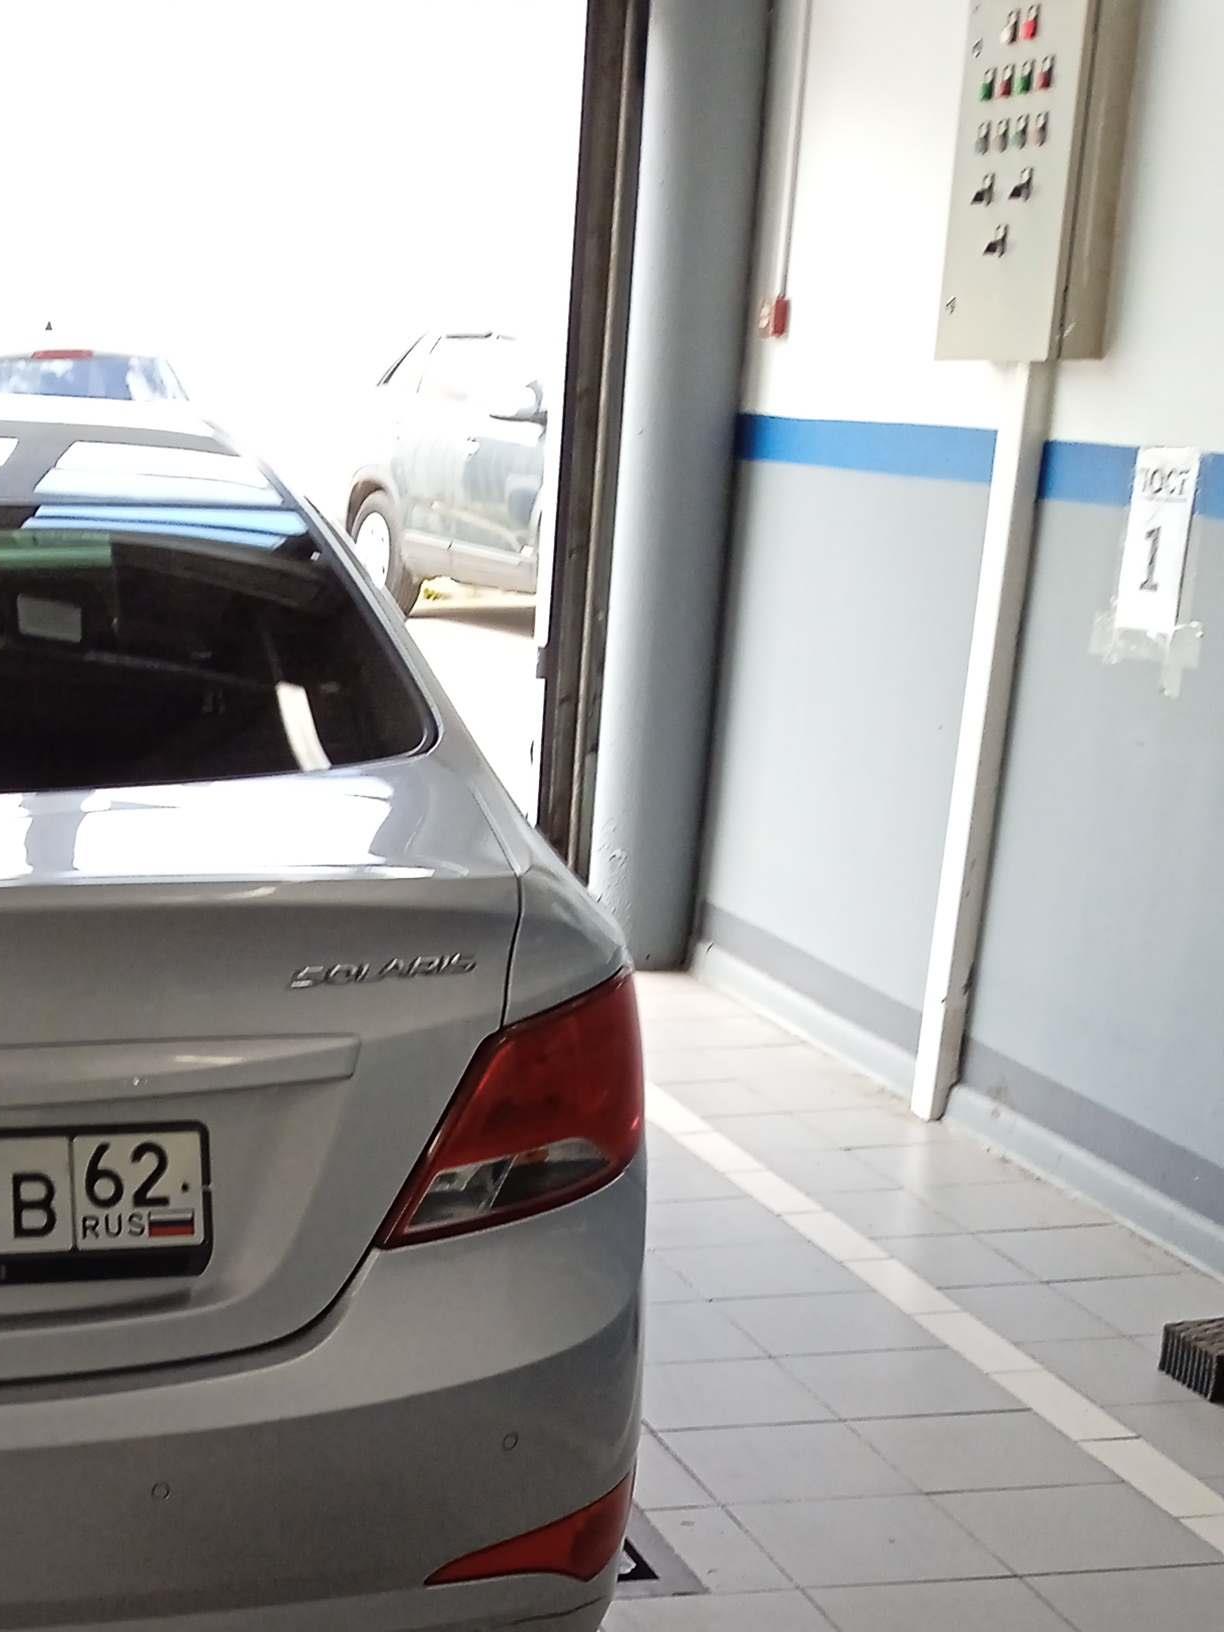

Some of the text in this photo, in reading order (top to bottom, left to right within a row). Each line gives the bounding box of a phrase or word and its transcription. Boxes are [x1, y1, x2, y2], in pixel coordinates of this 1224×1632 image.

[1139, 526, 1162, 592] 1
[288, 952, 478, 990] SOLARIS
[84, 1141, 171, 1209] 62
[81, 1212, 146, 1240] RUS
